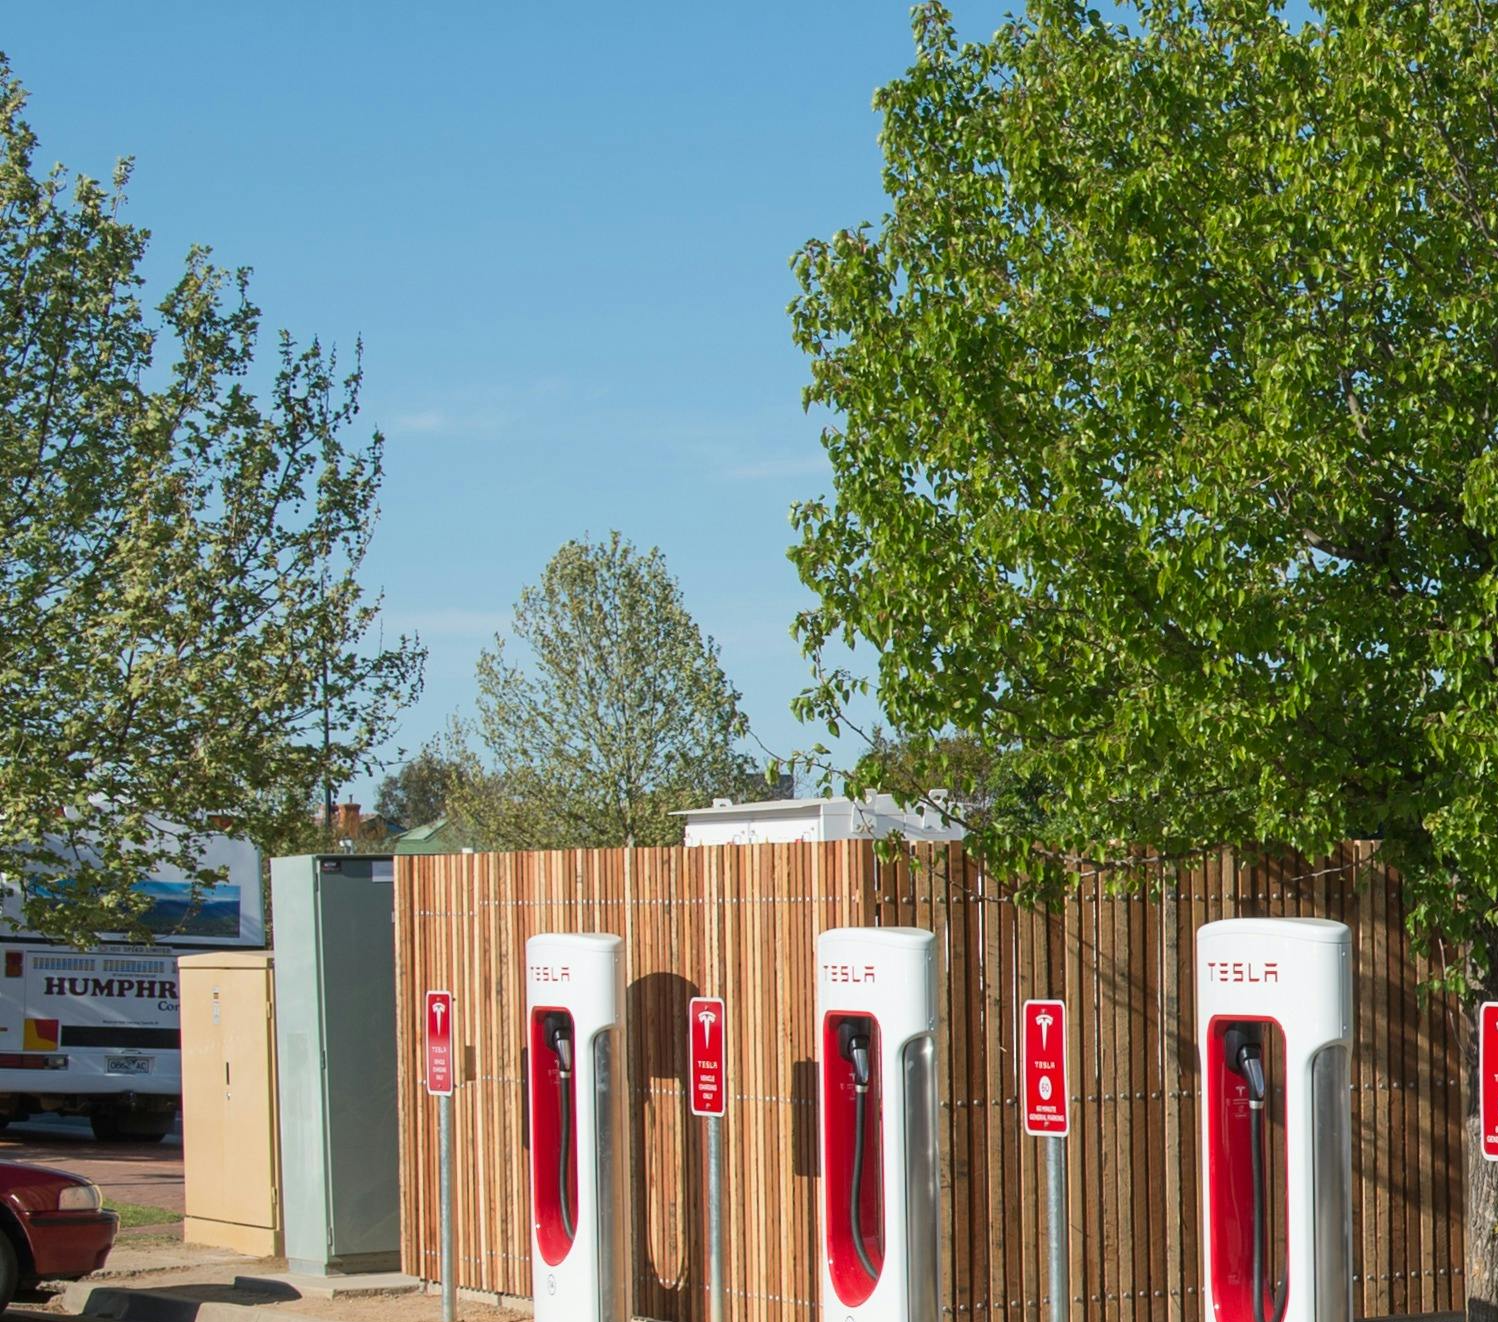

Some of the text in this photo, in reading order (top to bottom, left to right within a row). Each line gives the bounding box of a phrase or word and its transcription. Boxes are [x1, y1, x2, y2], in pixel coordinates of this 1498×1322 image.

[530, 966, 570, 982] TESLA
[824, 965, 875, 983] TESLA
[1207, 962, 1278, 982] TESLA
[44, 976, 179, 999] HUMPHR
[698, 1060, 718, 1069] TESLA
[1035, 1061, 1055, 1069] TESLA
[1041, 1083, 1050, 1093] 60
